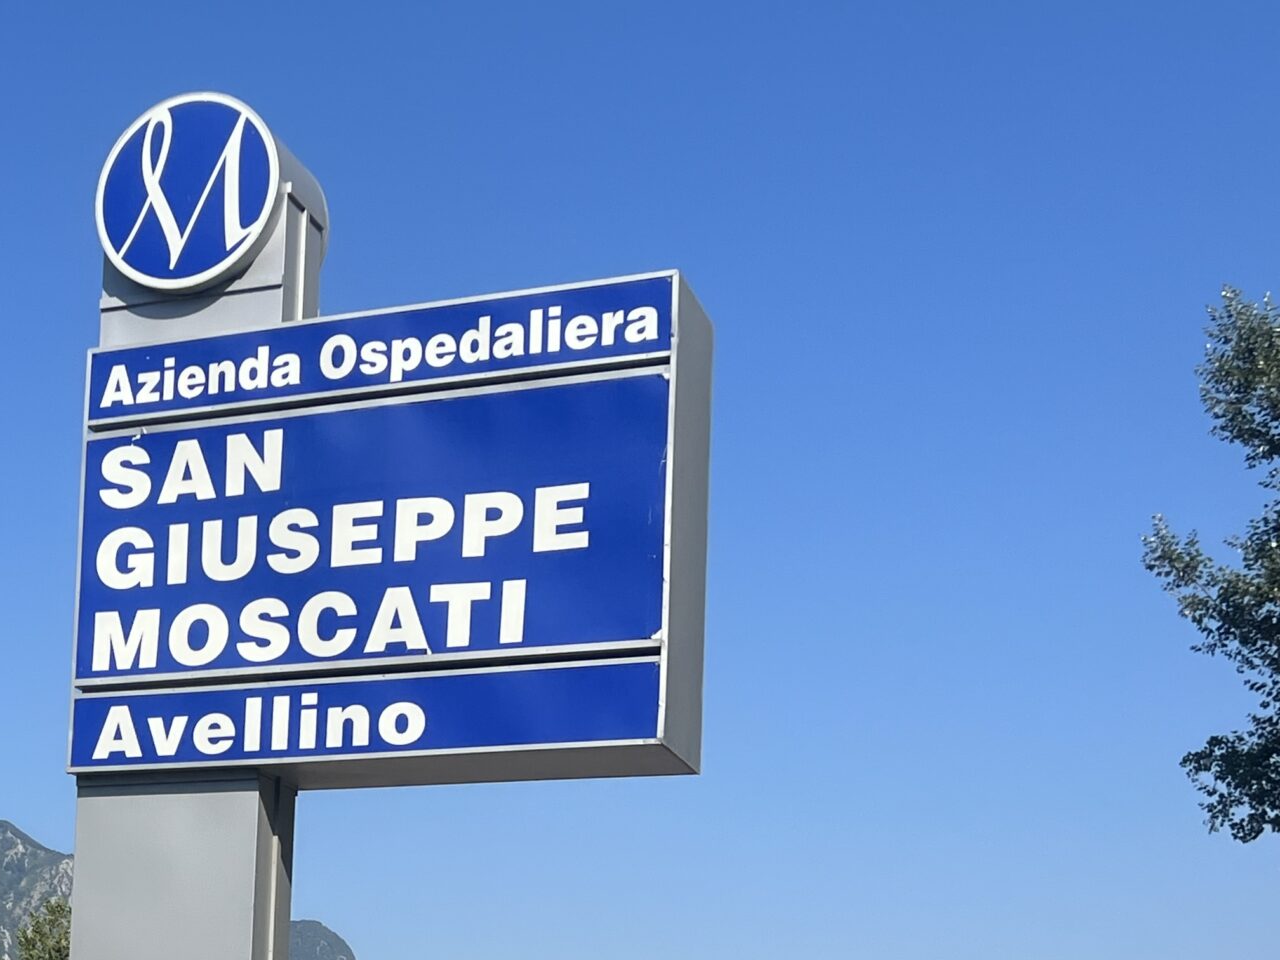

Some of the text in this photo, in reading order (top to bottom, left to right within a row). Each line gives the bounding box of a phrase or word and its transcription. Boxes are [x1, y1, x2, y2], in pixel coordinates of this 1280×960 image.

[100, 304, 660, 409] Azienda Ospedaliera
[99, 428, 284, 510] SAN
[95, 482, 590, 590] GIUSEPPE
[91, 578, 527, 672] MOSCATI
[92, 691, 426, 760] Avellino
